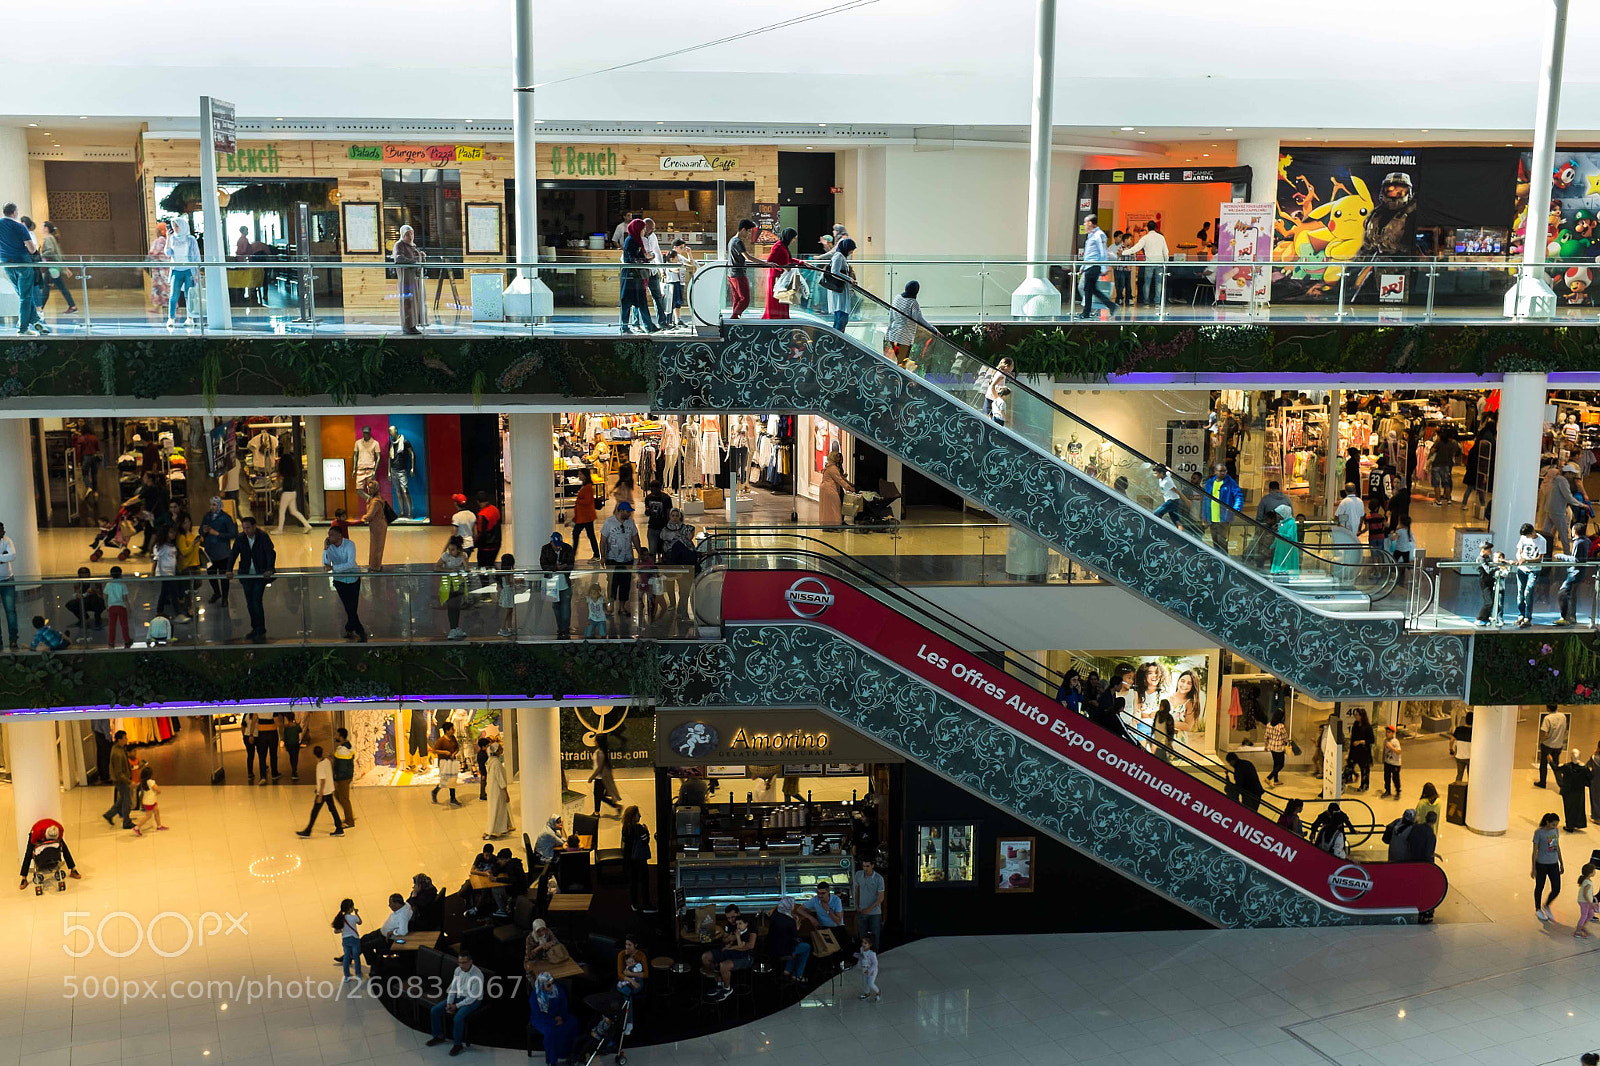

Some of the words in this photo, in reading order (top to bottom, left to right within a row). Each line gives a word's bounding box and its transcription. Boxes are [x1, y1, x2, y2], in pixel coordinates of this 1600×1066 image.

[351, 145, 380, 159] Salads
[385, 145, 426, 164] Burgers
[425, 145, 454, 168] Pizza
[453, 145, 484, 159] Pasta
[1371, 155, 1400, 165] MOROCCO
[1400, 155, 1417, 166] MALL
[663, 157, 705, 169] Croissant
[1137, 171, 1170, 181] ENTRÉE
[1381, 276, 1404, 297] NRJ
[1177, 445, 1199, 455] 800
[1178, 463, 1198, 473] 400
[1370, 474, 1381, 487] 23
[790, 592, 830, 603] NISSAN
[730, 728, 829, 749] Amorino
[780, 749, 833, 757] NATURALE
[916, 644, 950, 670] Les
[951, 663, 1008, 701] Offres
[1005, 694, 1049, 726] Auto
[1050, 718, 1095, 752] Expo
[1096, 747, 1192, 806] continuent
[1191, 799, 1235, 829] avec
[1232, 820, 1298, 863] NISSAN
[1332, 877, 1369, 889] NISSAN
